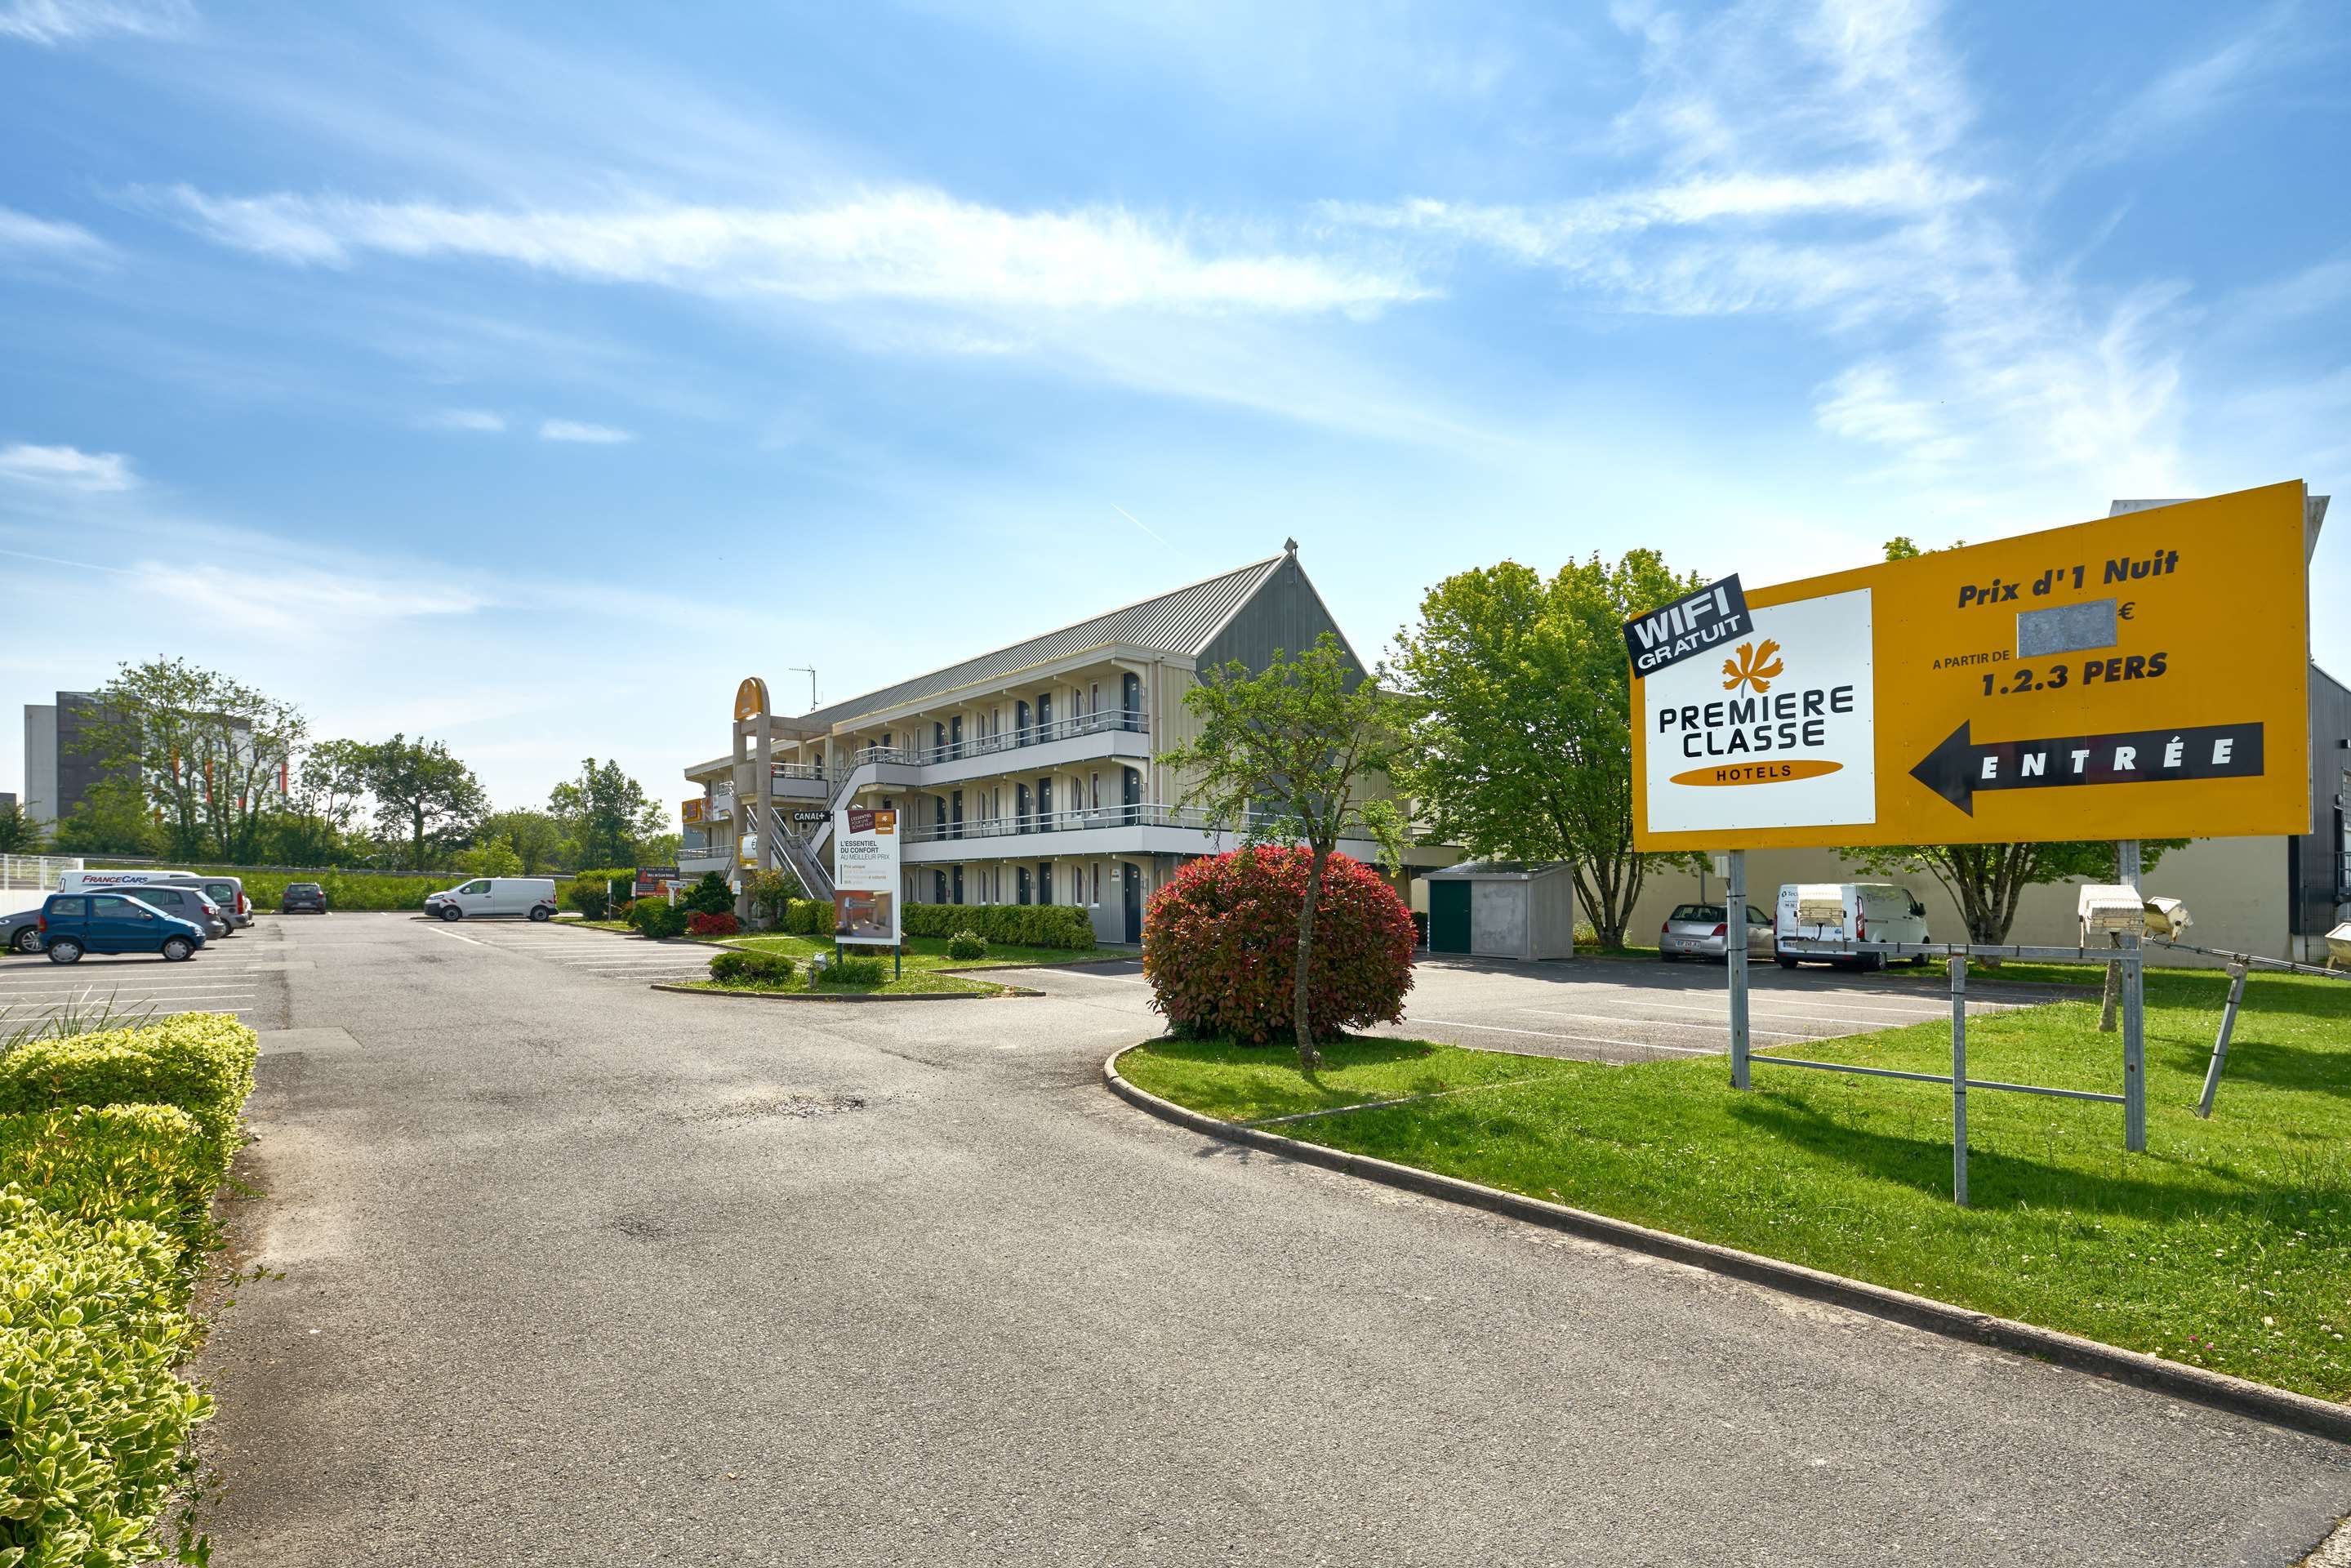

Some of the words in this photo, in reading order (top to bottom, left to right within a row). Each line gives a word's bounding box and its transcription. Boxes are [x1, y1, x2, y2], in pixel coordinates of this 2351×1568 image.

[1957, 578, 2021, 608] Prix
[2103, 549, 2180, 585] Nuit
[1633, 586, 1730, 650] WIFI
[2117, 601, 2136, 621] €
[1637, 614, 1741, 670] GRATUIT
[1932, 659, 1942, 670] A
[1944, 653, 1989, 669] PARTIR
[1992, 650, 2010, 662] DE
[1982, 665, 2069, 697] 1.2.3
[2082, 652, 2169, 686] PERS
[1659, 684, 1855, 734] PREMIERE
[1683, 719, 1825, 759] CLASSE
[1980, 735, 2234, 780] ENTRÉE
[1716, 764, 1792, 782] HOTELS
[794, 812, 826, 821] CANAL+
